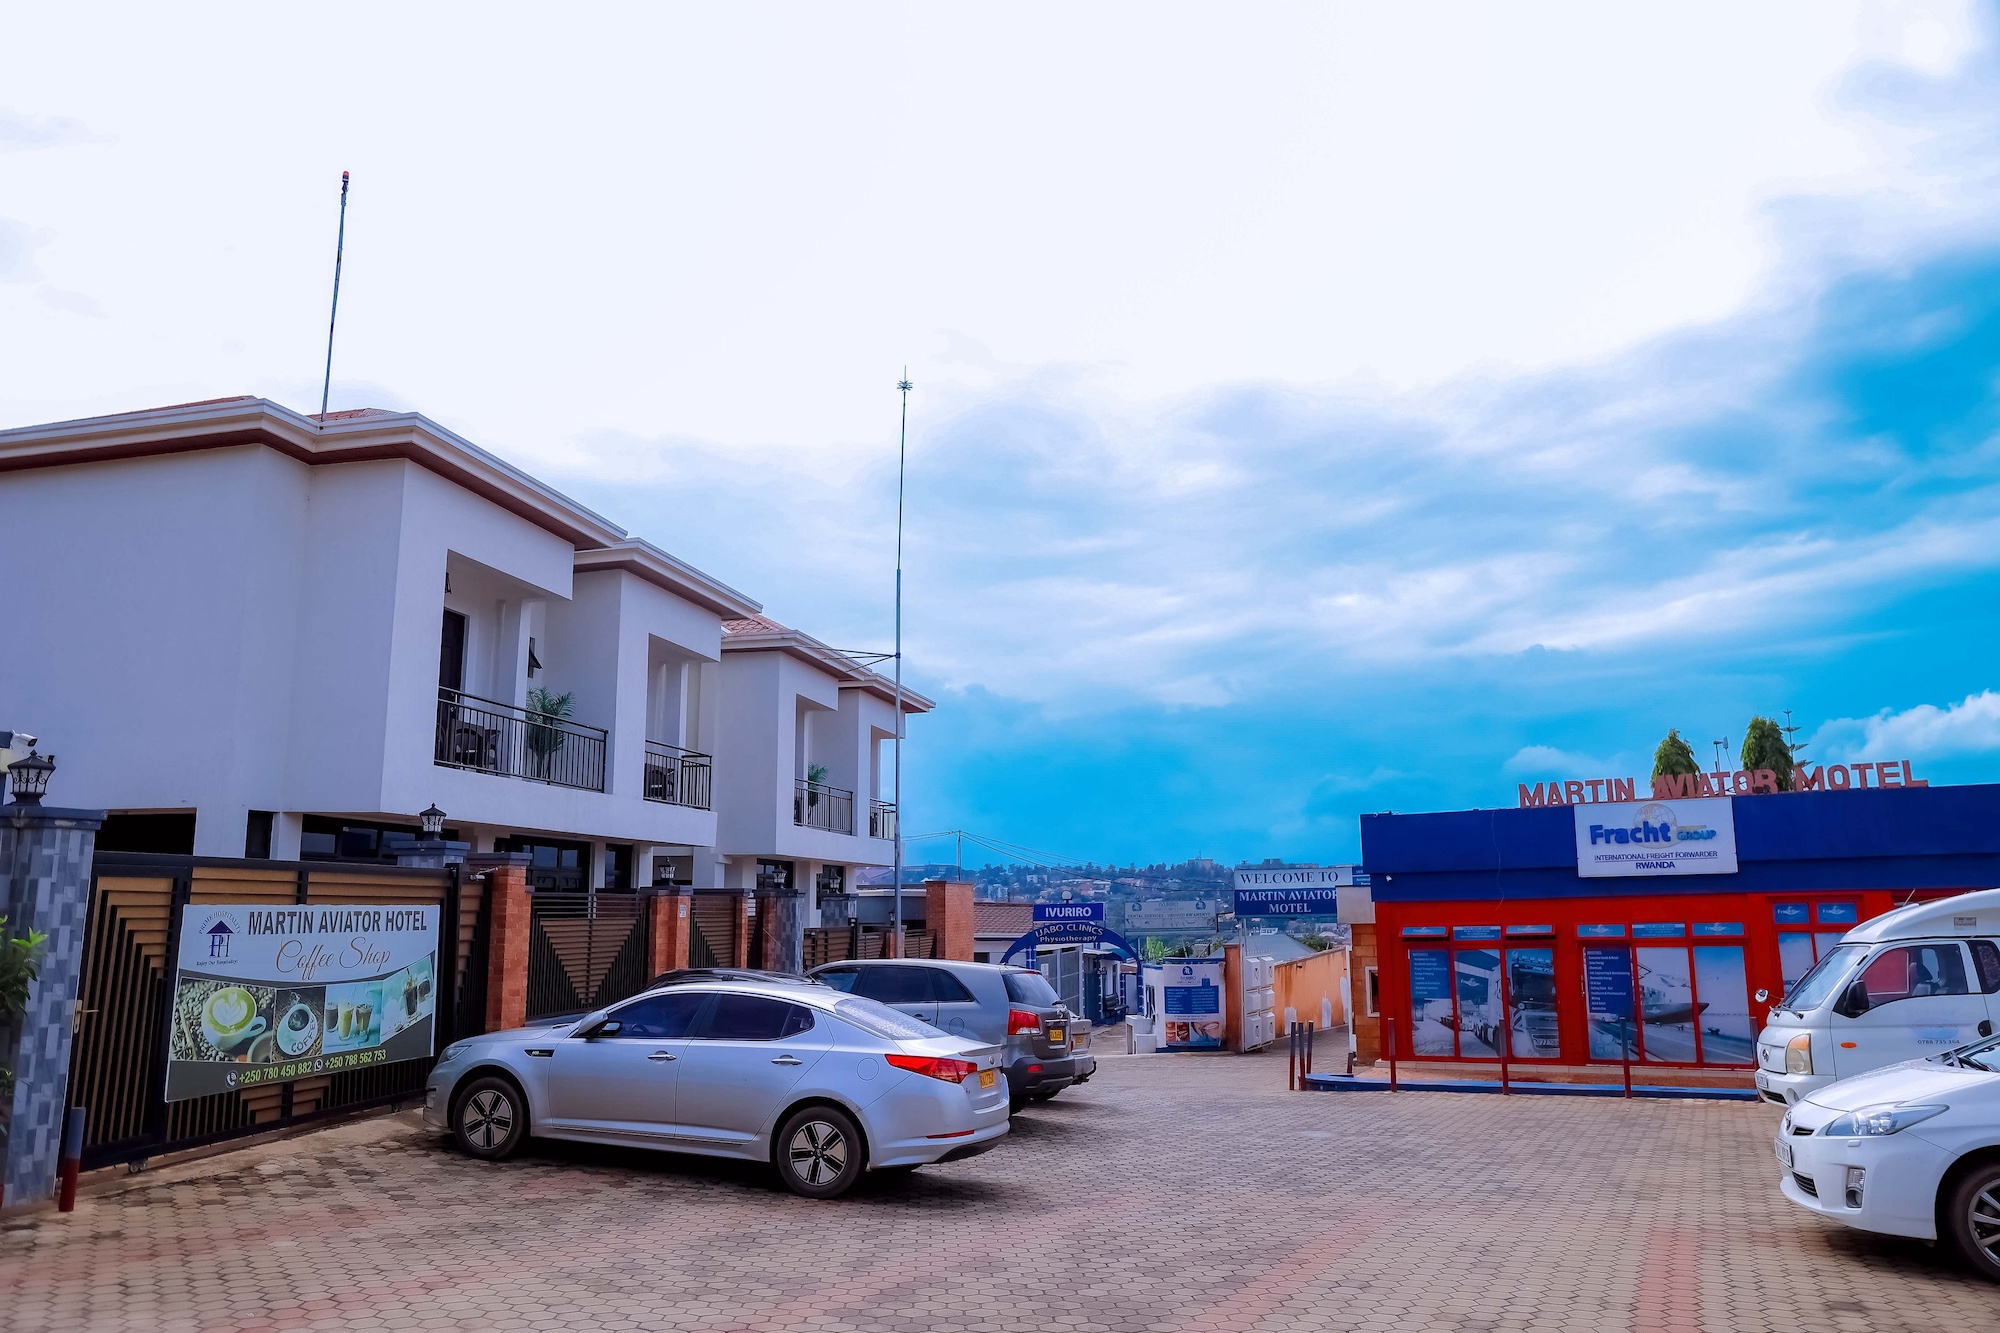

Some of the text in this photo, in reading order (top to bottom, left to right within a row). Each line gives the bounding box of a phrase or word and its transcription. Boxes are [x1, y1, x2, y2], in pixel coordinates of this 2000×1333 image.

[1518, 760, 1928, 808] MARTIN AVIATOR MOTEL
[1590, 821, 1717, 845] Fracht GROUP
[1594, 853, 1645, 861] INTERNATIONAL
[1675, 850, 1718, 858] FORWARDER
[1635, 861, 1676, 869] RWANDA
[1240, 871, 1339, 884] WELCOME TO
[1239, 889, 1337, 901] MARTIN AVIATOR
[1045, 907, 1092, 917] IVURIRO
[1269, 903, 1312, 914] MOTEL
[199, 910, 242, 935] PRIME HOSPITALITY
[248, 910, 428, 936] MARTIN AVIATOR HOTEL
[1035, 923, 1104, 937] IJABO CLINICS
[1040, 935, 1097, 943] Physiotherapy
[276, 936, 391, 981] Coffee Shop
[291, 1016, 316, 1053] COFFEE
[325, 1049, 387, 1069] +250 788 562 753
[239, 1061, 313, 1084] +250 780 450 882
